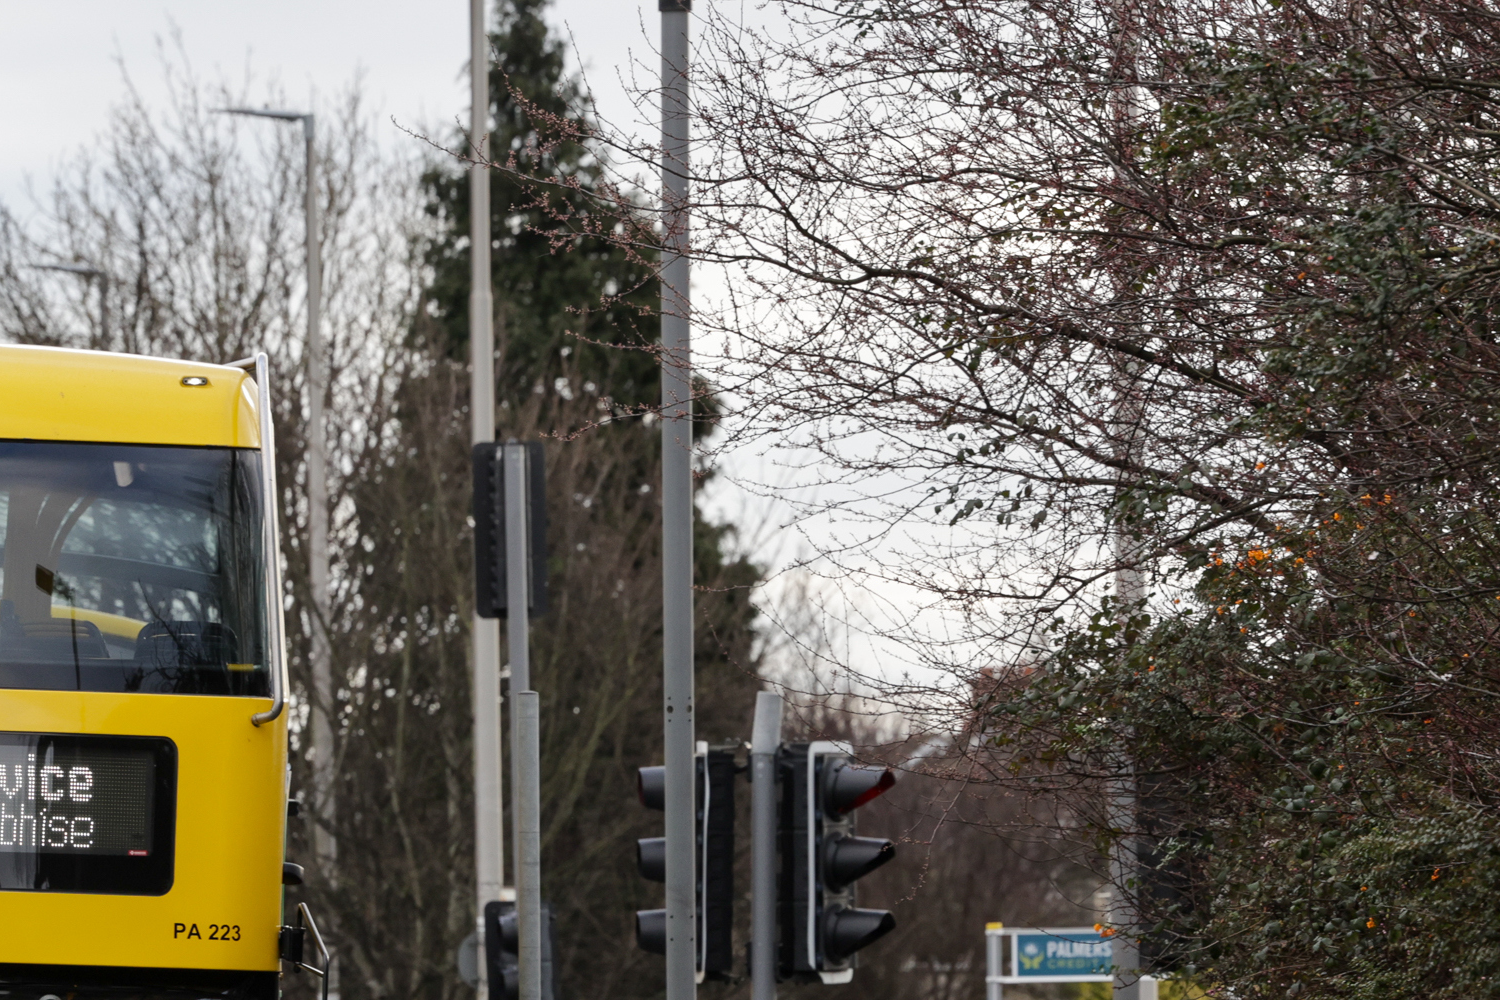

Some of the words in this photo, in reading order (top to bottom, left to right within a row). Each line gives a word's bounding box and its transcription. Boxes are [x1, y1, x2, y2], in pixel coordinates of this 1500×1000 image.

[173, 922, 202, 940] PA
[207, 923, 242, 942] 223
[1047, 941, 1112, 958] PALMERS
